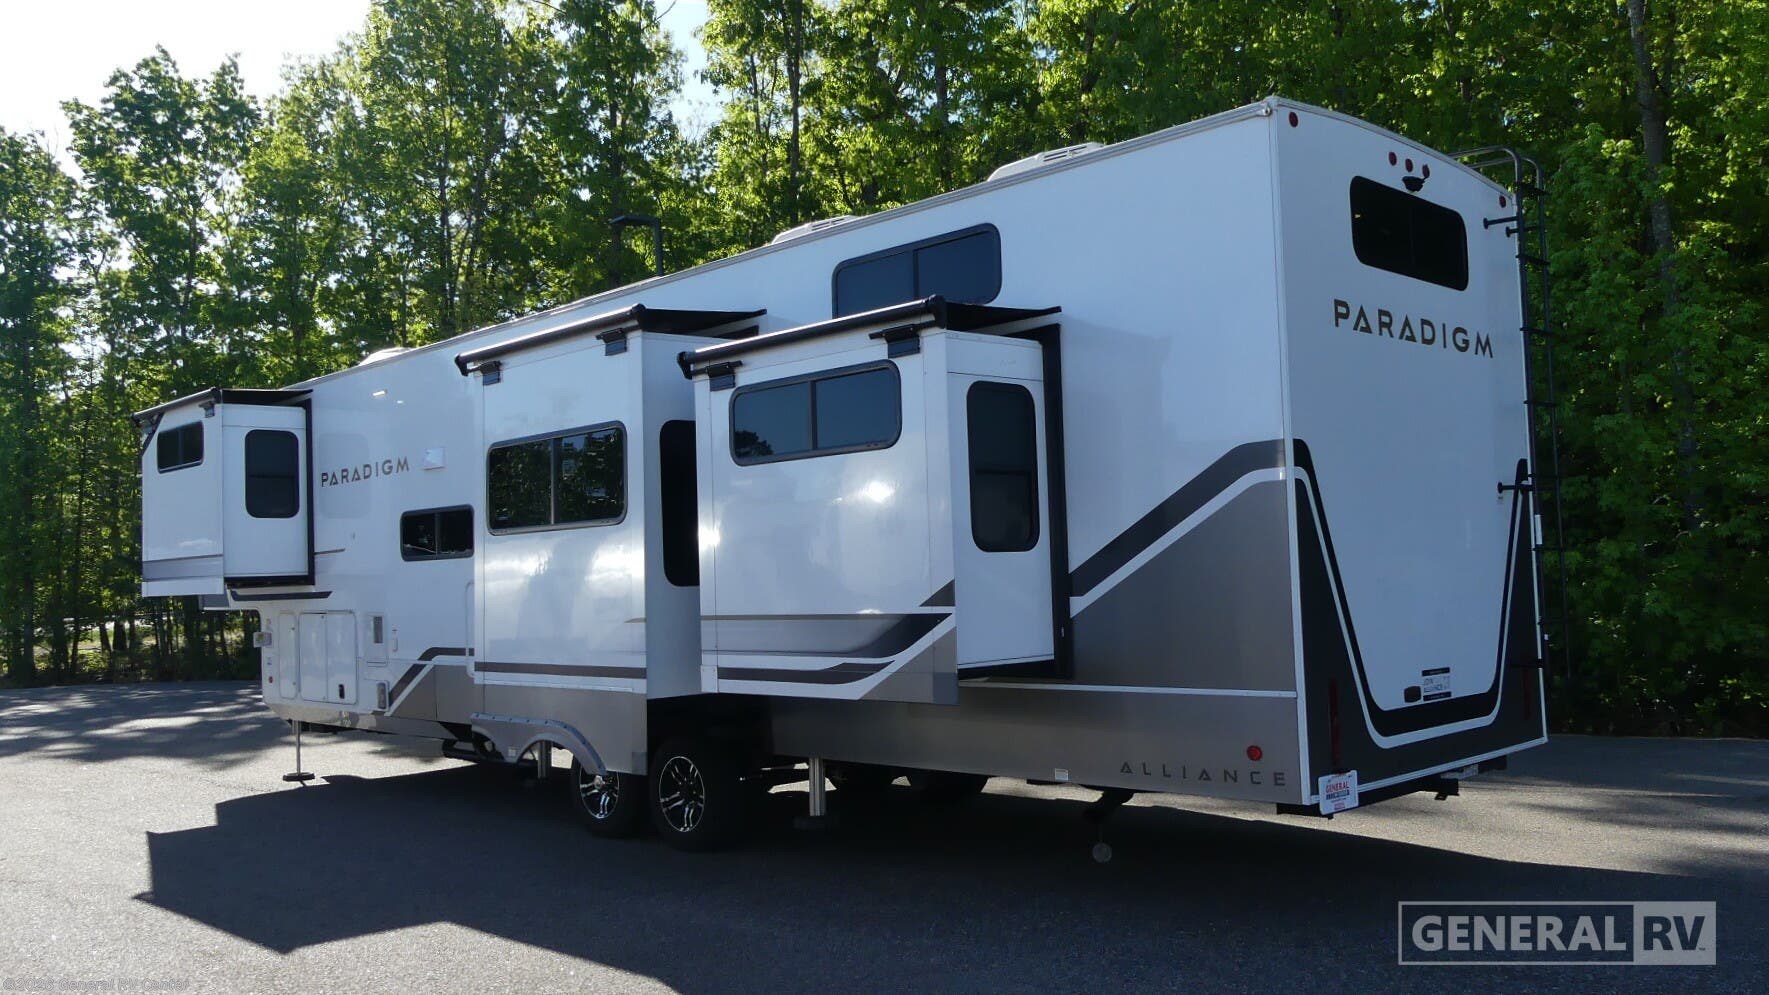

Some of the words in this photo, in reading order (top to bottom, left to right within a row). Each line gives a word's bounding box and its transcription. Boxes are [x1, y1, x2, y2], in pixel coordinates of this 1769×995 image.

[1333, 298, 1494, 359] PARADIGM
[321, 456, 410, 488] PARADIGM
[1120, 761, 1286, 787] ALLIANCE
[1326, 780, 1350, 793] GENERAL
